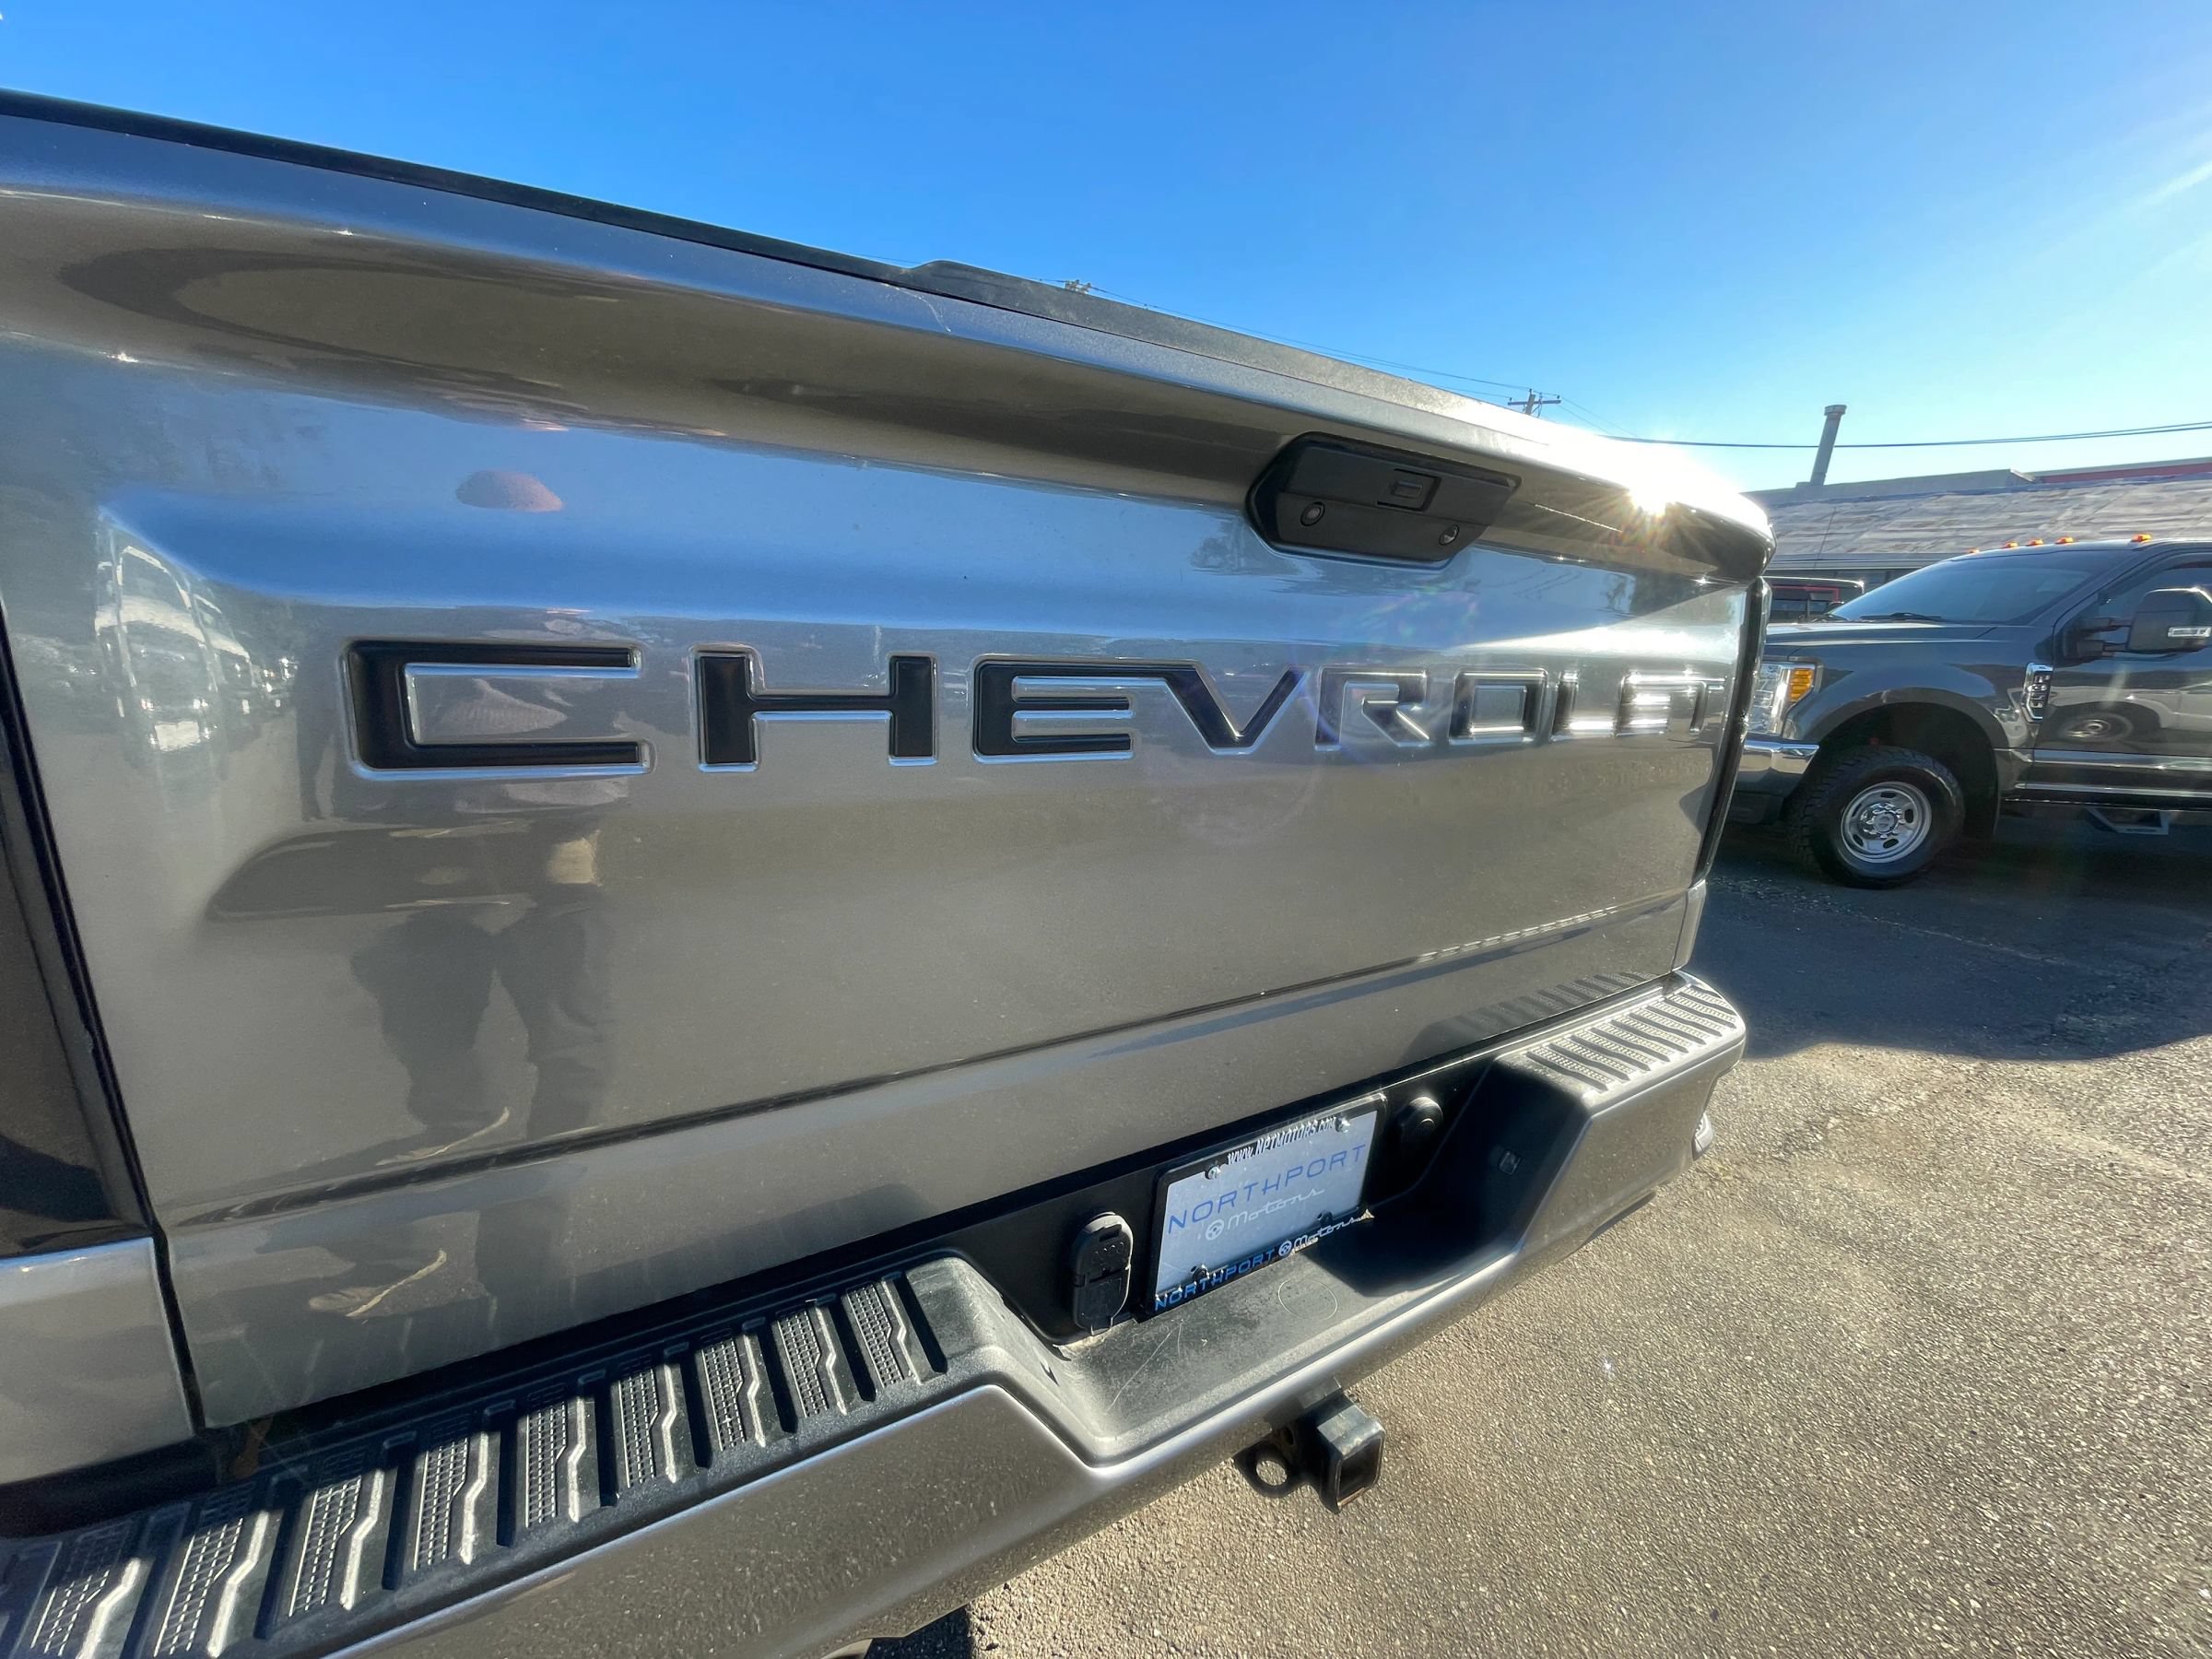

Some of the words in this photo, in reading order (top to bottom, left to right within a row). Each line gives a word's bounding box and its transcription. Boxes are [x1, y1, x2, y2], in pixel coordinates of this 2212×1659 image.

[347, 638, 1726, 776] CHEVROLET
[1168, 1144, 1366, 1235] NORTHPORT
[1155, 1248, 1275, 1311] NORTHPORT
